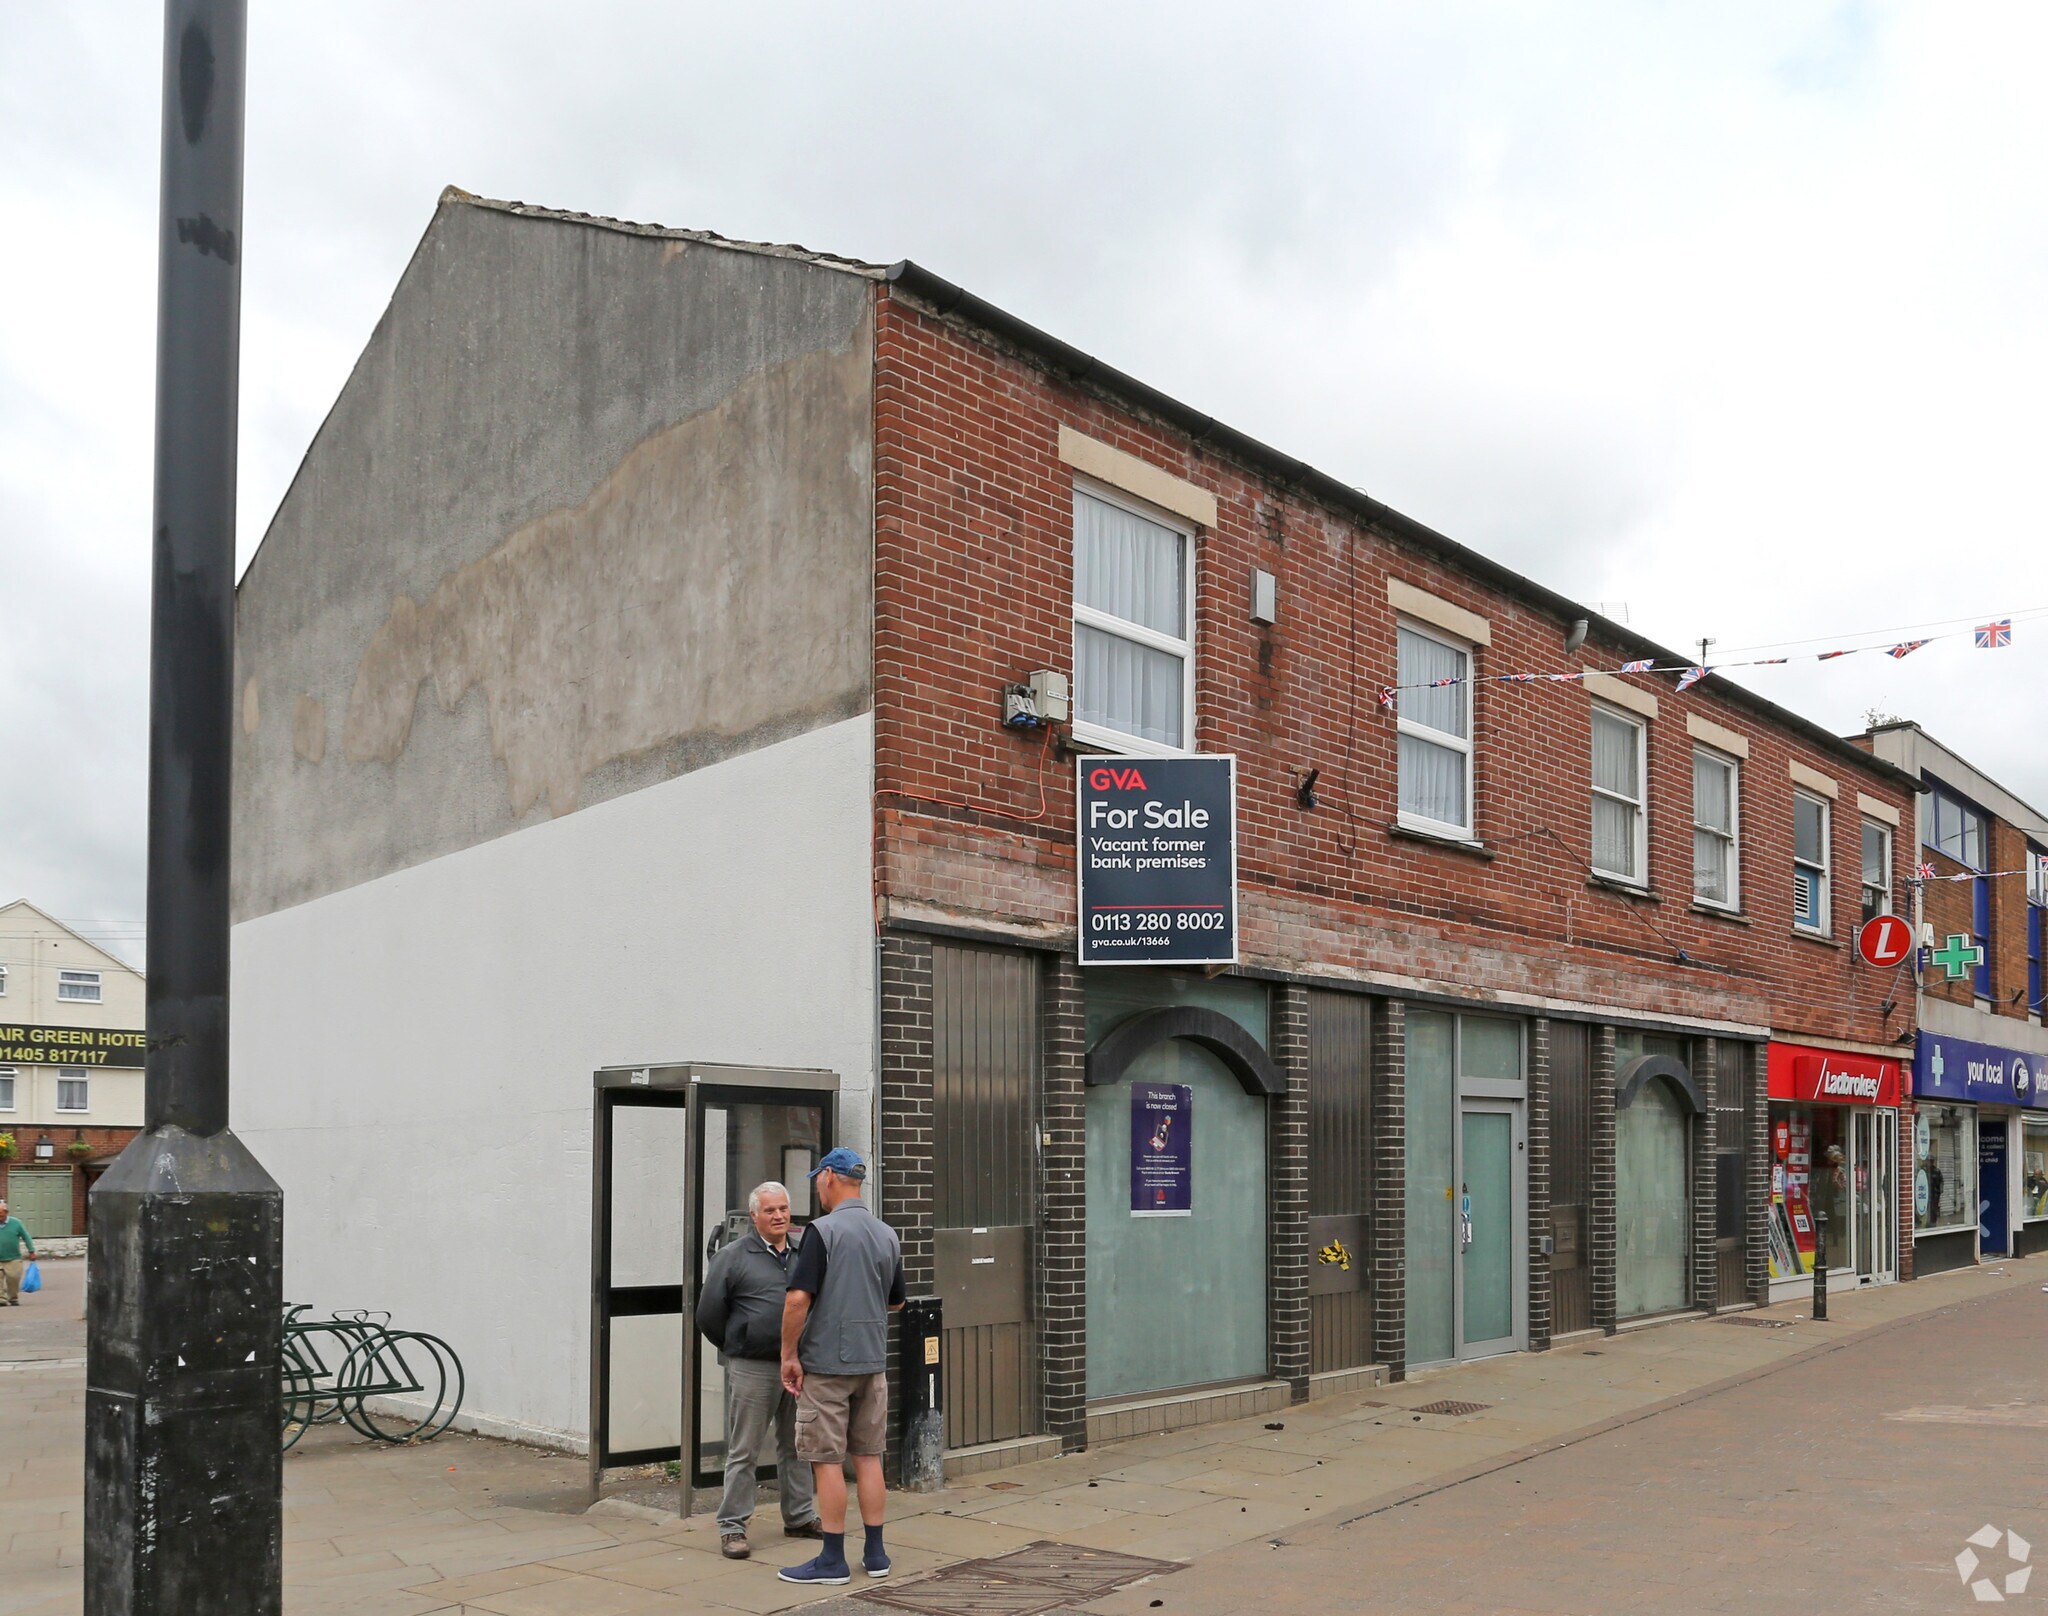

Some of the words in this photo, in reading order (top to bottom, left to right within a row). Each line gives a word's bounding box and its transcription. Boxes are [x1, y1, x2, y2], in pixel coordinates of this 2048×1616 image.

[1090, 768, 1147, 791] GVA
[1090, 801, 1138, 829] For
[1143, 800, 1210, 829] Sale
[1090, 837, 1149, 851] Vacant
[1152, 836, 1206, 851] former
[1091, 854, 1132, 869] bank
[1136, 854, 1206, 872] premises
[1091, 913, 1131, 931] 0113
[1136, 912, 1171, 930] 280
[1176, 912, 1225, 930] 8002
[1091, 936, 1170, 949] gva.co.uk/13666
[1874, 922, 1897, 959] L
[0, 1027, 25, 1042] AIR
[30, 1029, 93, 1045] GREEN
[98, 1032, 146, 1048] HOTE
[0, 1046, 45, 1061] 1405
[49, 1048, 108, 1064] 817117
[1824, 1071, 1877, 1097] Ladbrokes
[1967, 1061, 1984, 1086] your
[1986, 1058, 2003, 1085] local
[2035, 1068, 2048, 1093] pha
[1148, 1091, 1158, 1099] This
[1159, 1092, 1176, 1100] branch
